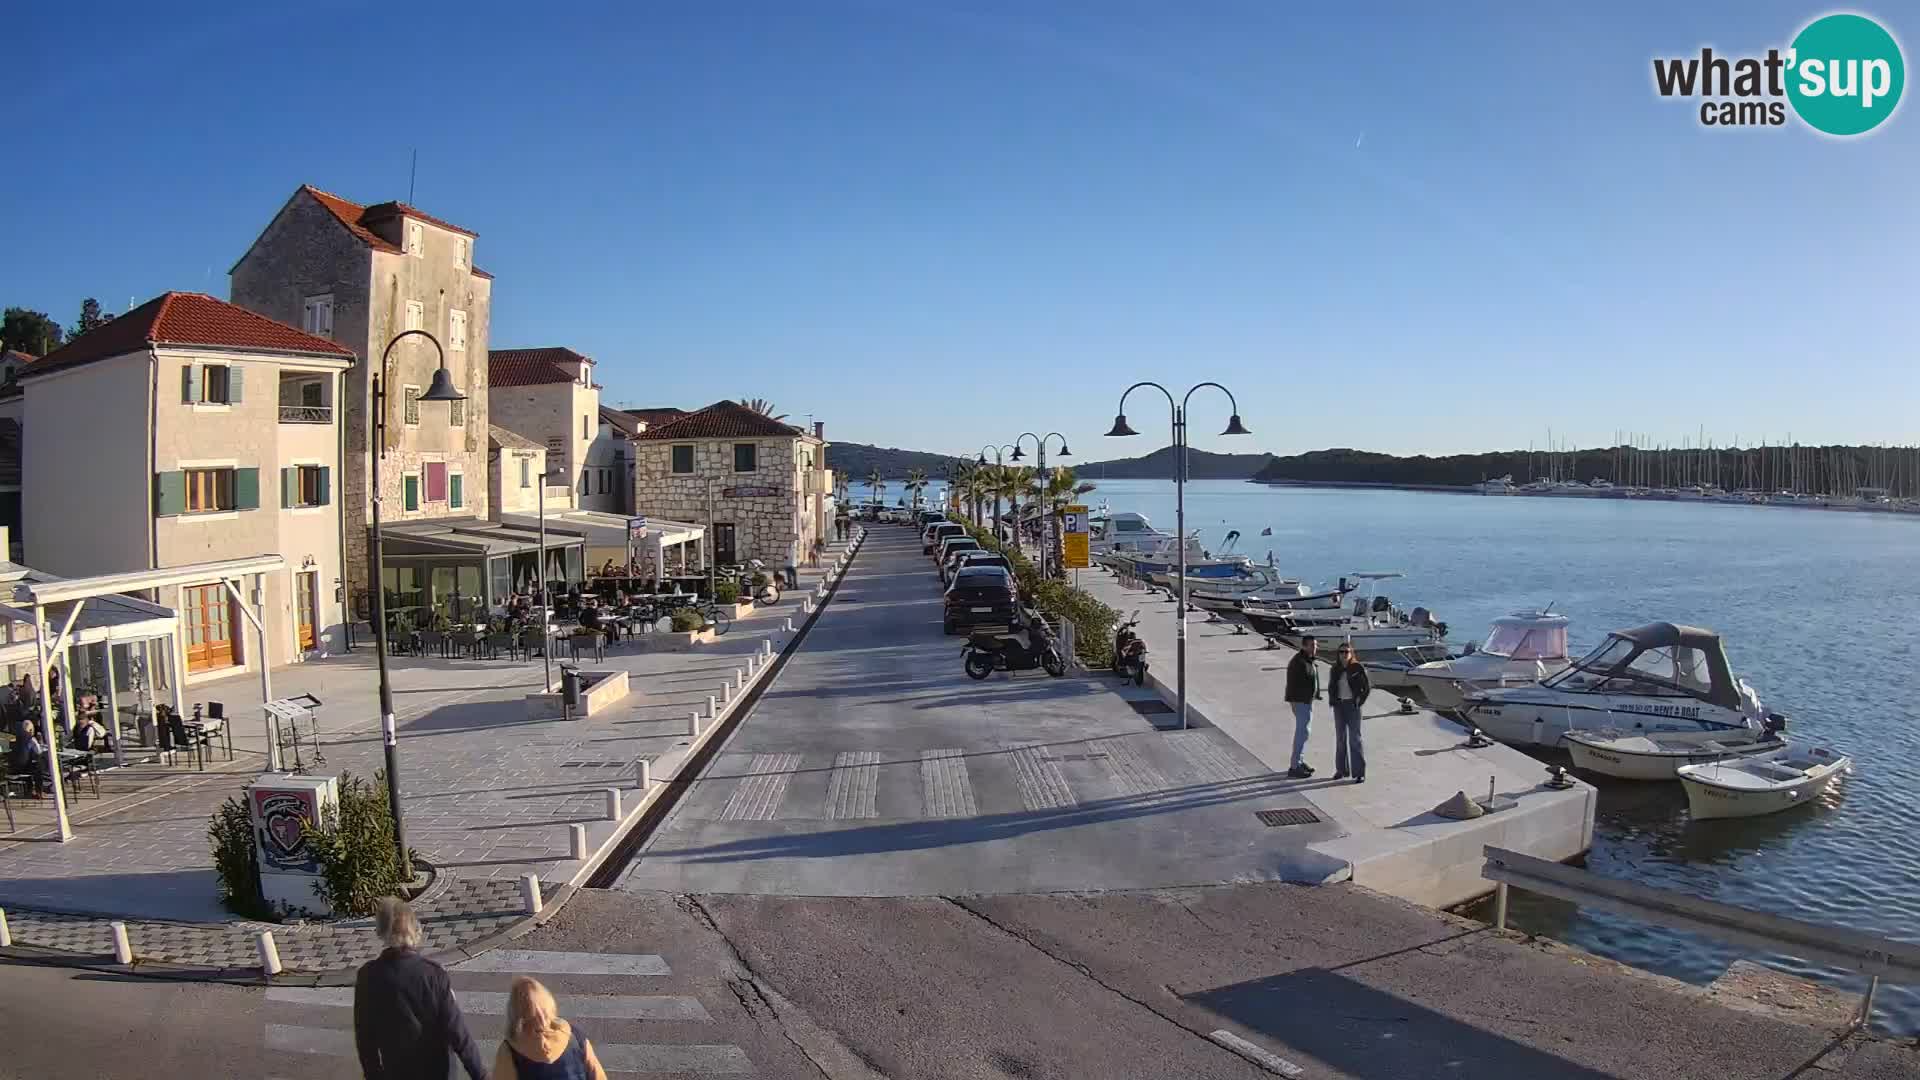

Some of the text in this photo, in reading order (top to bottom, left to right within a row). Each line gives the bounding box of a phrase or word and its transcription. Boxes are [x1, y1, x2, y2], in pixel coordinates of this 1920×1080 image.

[1065, 515, 1076, 531] P
[1654, 704, 1674, 716] RENT
[1681, 706, 1700, 719] BOAT
